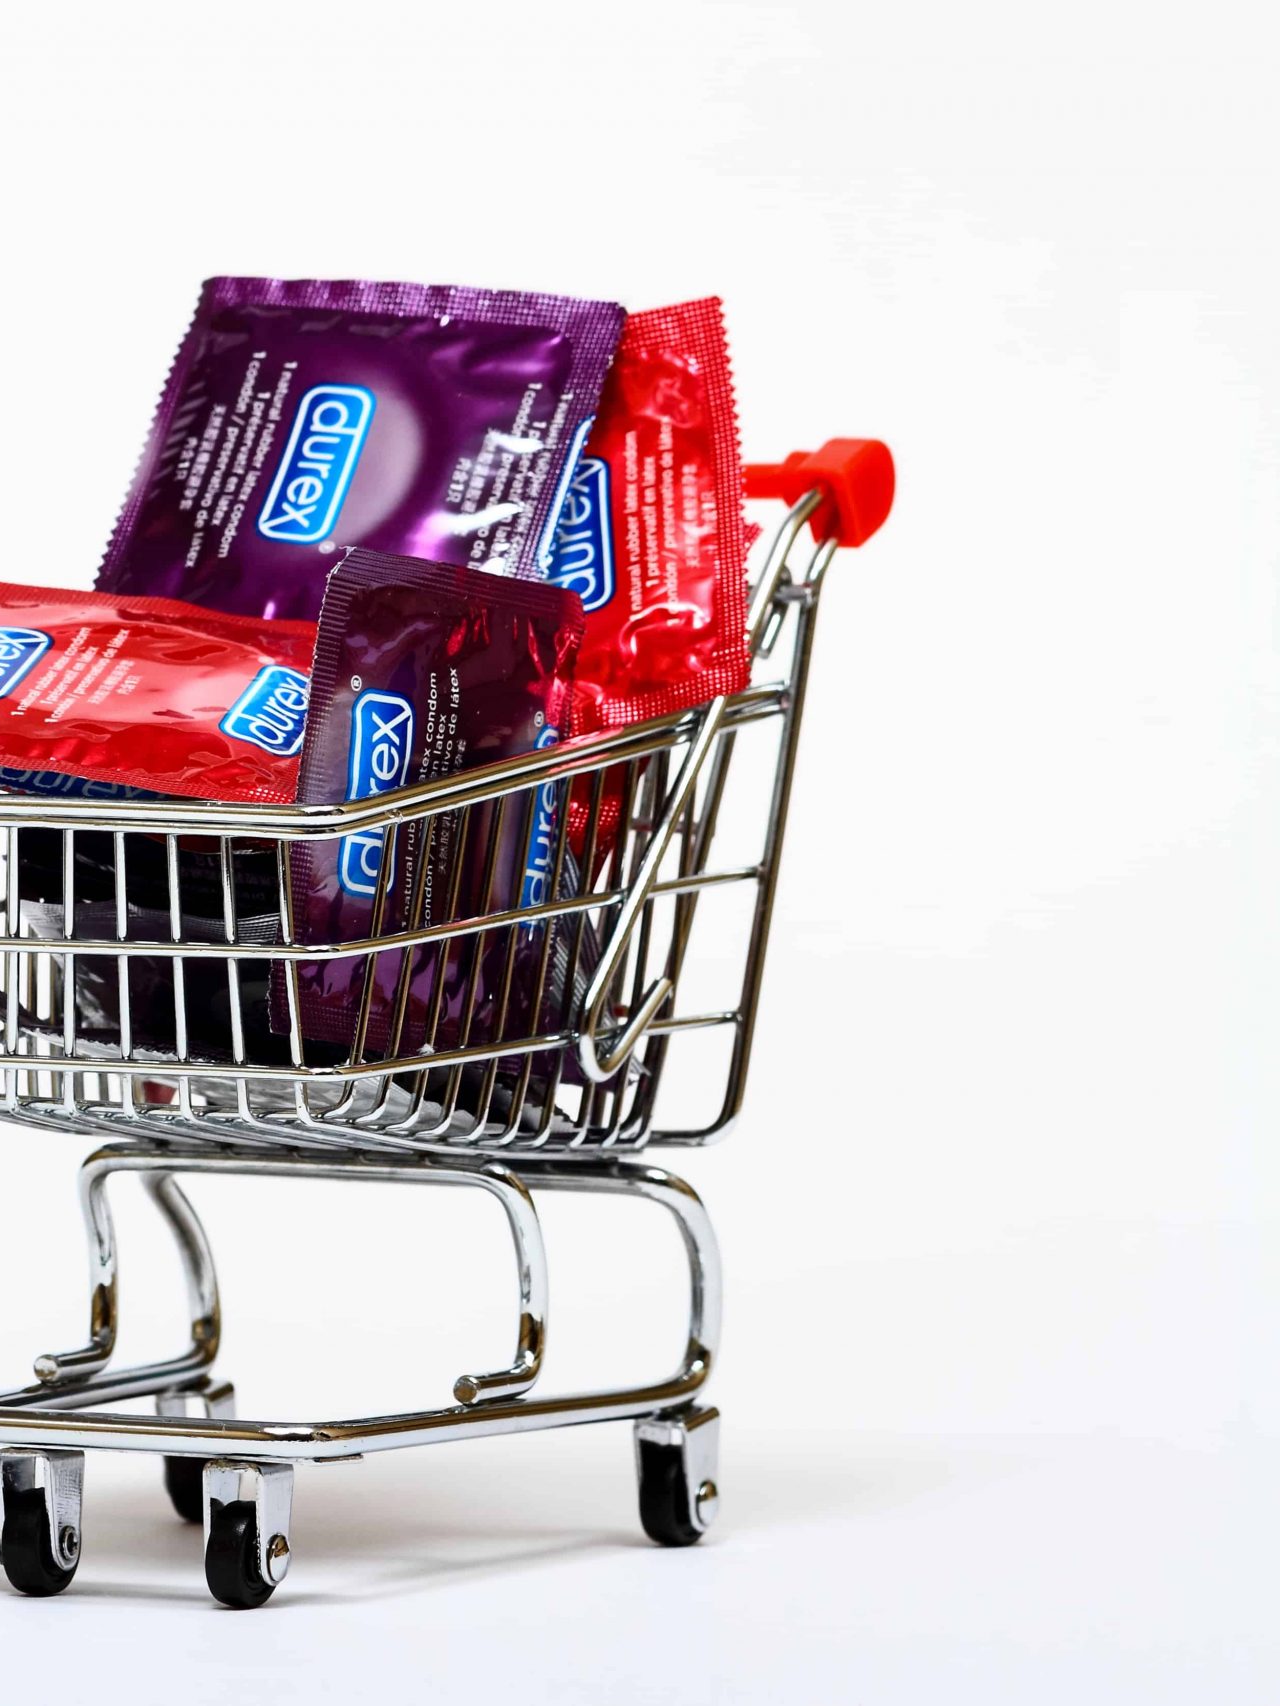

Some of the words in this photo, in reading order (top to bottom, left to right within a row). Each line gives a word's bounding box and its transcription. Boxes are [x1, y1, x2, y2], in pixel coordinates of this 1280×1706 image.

[268, 371, 292, 421] natural
[252, 422, 277, 468] rubber
[261, 400, 358, 529] durex
[623, 430, 638, 481] condom
[659, 451, 673, 468] de
[224, 476, 238, 493] en
[238, 470, 261, 501] latex
[623, 483, 639, 514] latex
[644, 487, 656, 503] en
[194, 510, 208, 528] de
[217, 503, 245, 558] condom
[660, 469, 677, 549] preservativo
[470, 540, 486, 559] de
[626, 516, 640, 562] rubber
[627, 564, 642, 612] natural
[426, 672, 437, 742] condom
[450, 667, 460, 708] látex
[239, 676, 308, 745] durex
[448, 713, 458, 735] de
[434, 714, 447, 755] latex
